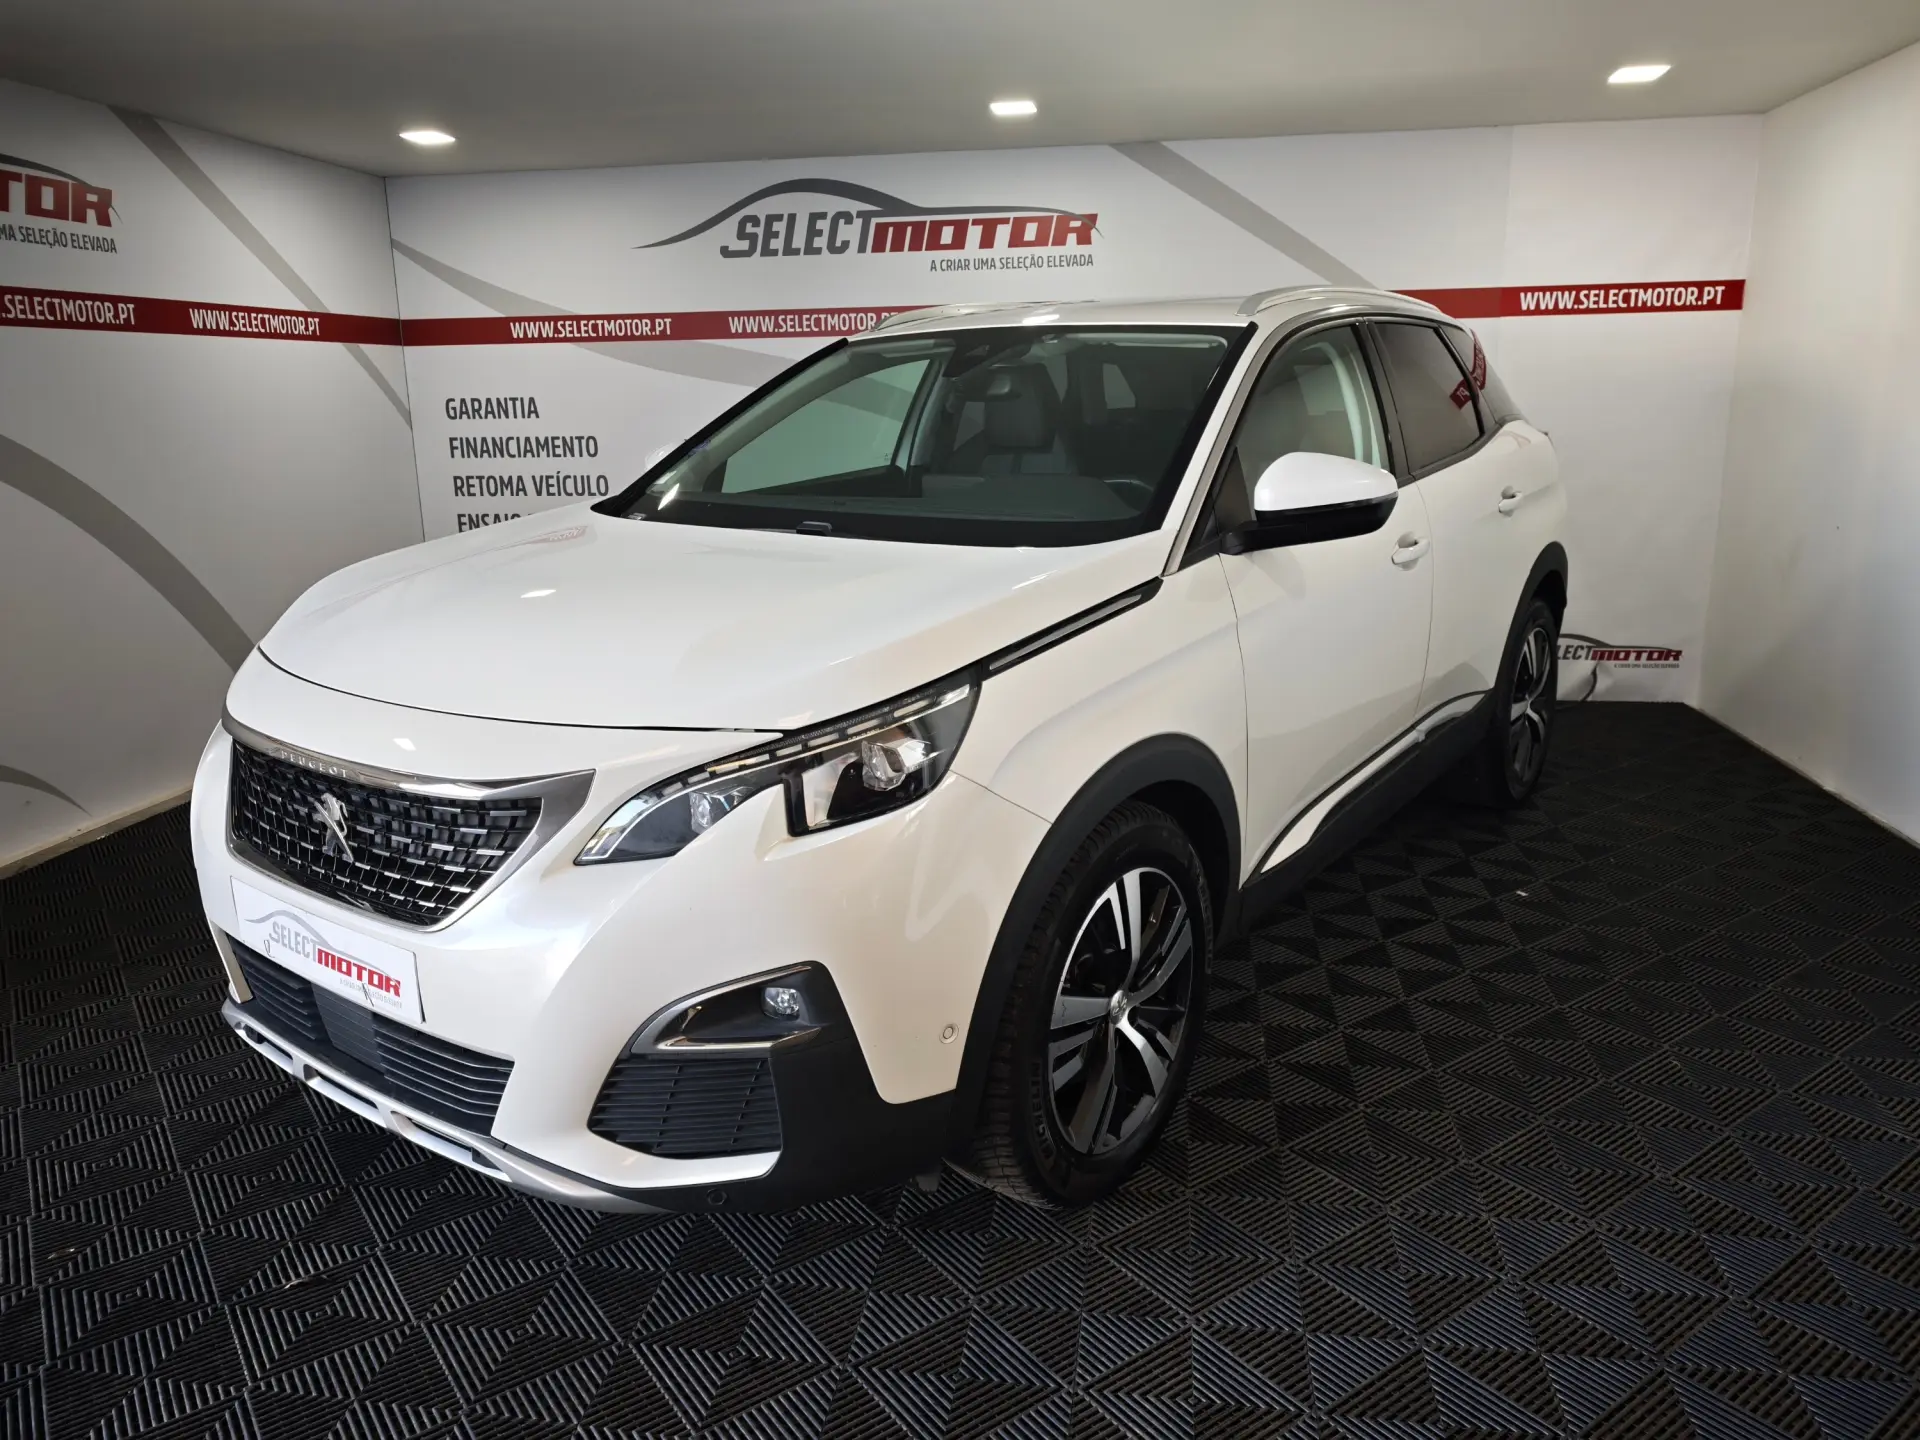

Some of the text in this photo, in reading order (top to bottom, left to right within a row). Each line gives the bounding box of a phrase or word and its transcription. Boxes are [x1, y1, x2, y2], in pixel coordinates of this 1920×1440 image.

[20, 226, 68, 249] SELEÇÃO
[70, 233, 118, 255] ELEVADA
[930, 254, 1094, 273] A CRIAR UMA SELEÇÃO ELEVADA
[1520, 285, 1726, 311] WWW.SELECTMOTOR.PT
[189, 308, 320, 336] WWW.SELECTMOTOR.PT
[510, 317, 672, 339] WWW.SELECTMOTOR.PT
[728, 312, 898, 334] WWW.SELECTMOTOR
[445, 396, 540, 420] GARANTIA
[448, 435, 599, 459] FINANCIAMENTO
[453, 470, 609, 497] RETOMA VEÍCULO
[457, 512, 521, 534] ENS
[280, 750, 348, 778] PEUGEOT
